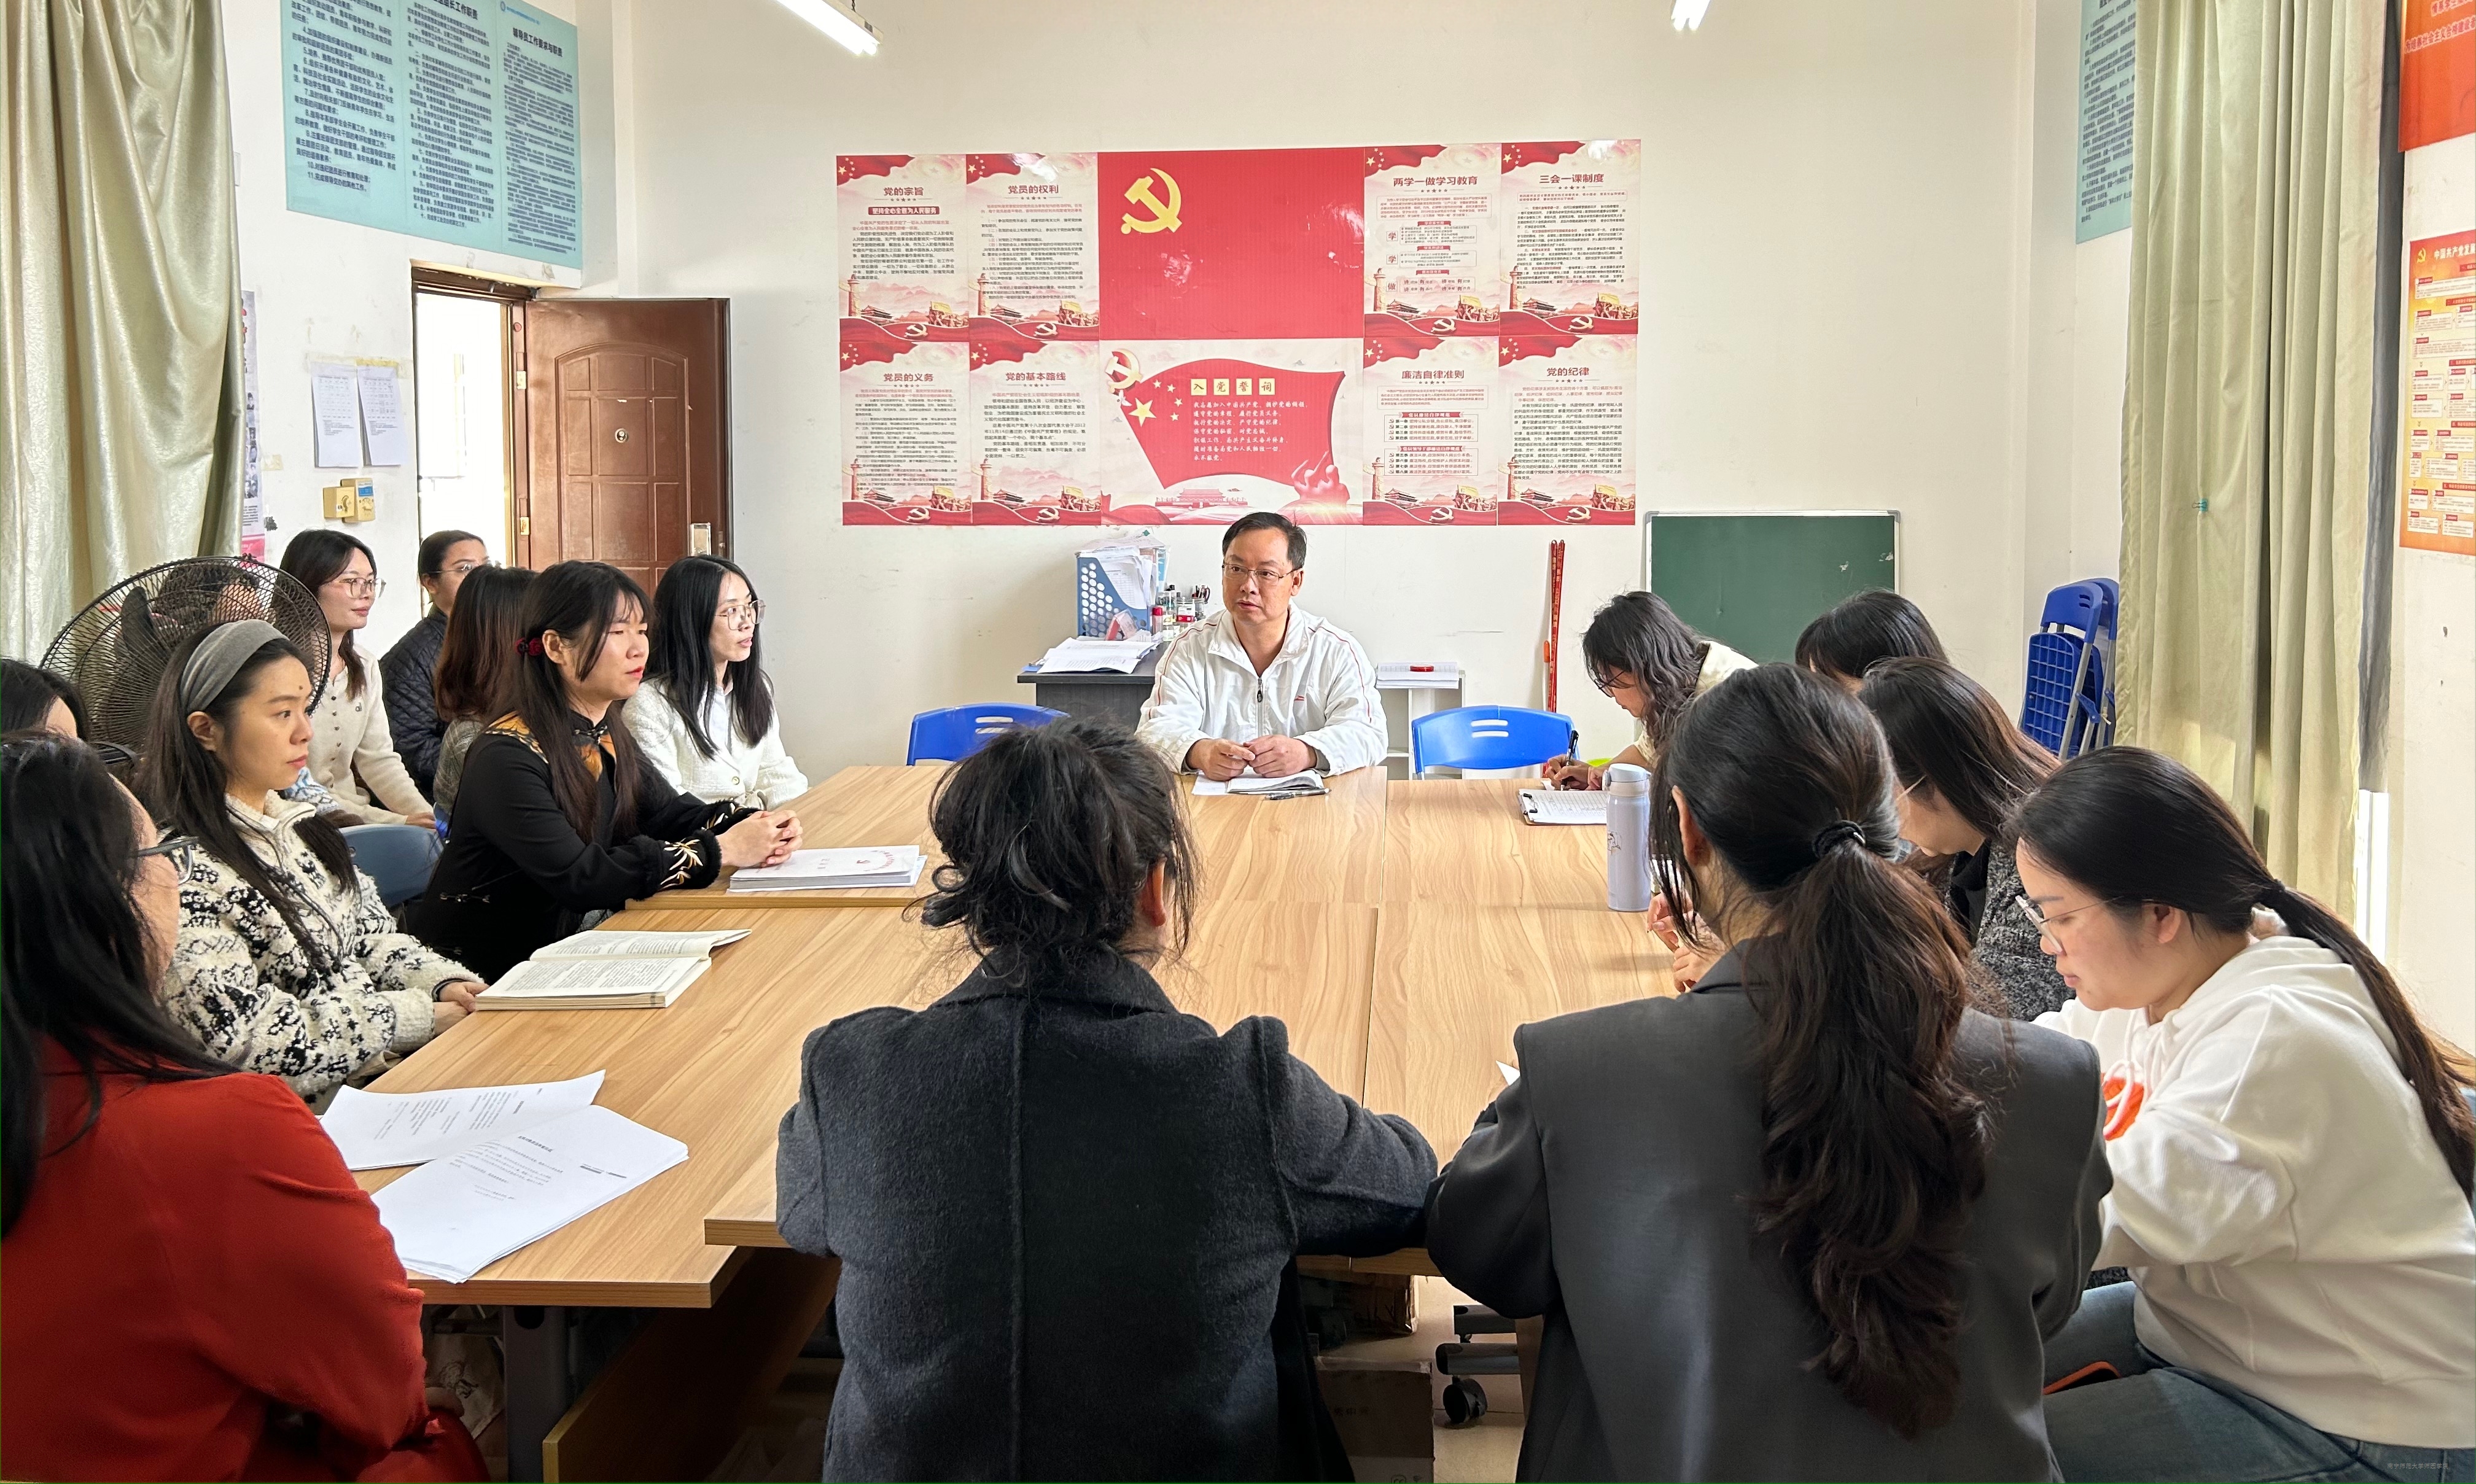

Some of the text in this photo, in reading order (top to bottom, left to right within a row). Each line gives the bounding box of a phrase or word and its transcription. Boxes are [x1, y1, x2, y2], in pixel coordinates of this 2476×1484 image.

[513, 28, 563, 57] 辅导员工作要求与职责
[1393, 176, 1478, 187] 两学一做学习教育
[1539, 173, 1604, 184] 三会一课制度
[884, 187, 924, 196] 党的宗旨
[1008, 185, 1058, 194] 党员的权利
[1388, 232, 1396, 241] 学
[1401, 370, 1465, 379] 廉洁自律准则
[1547, 367, 1589, 376] 党的纪律
[884, 373, 933, 382] 党员的义务
[1005, 373, 1065, 381] 党的基本路线
[1194, 381, 1272, 392] 入党誓词
